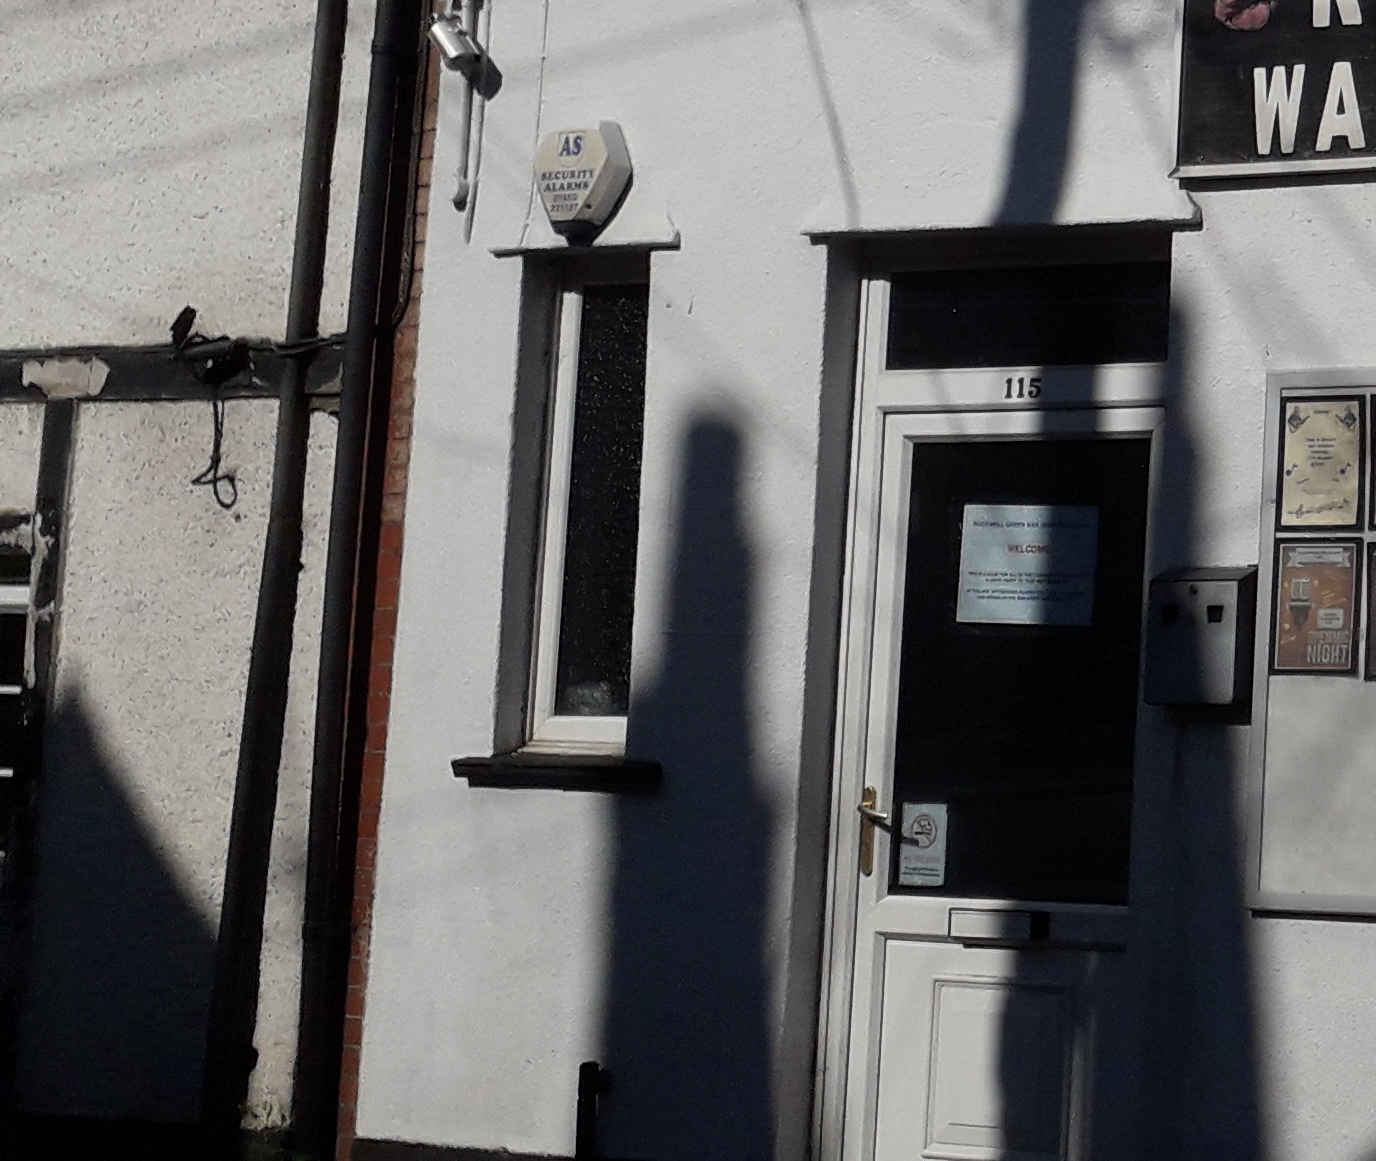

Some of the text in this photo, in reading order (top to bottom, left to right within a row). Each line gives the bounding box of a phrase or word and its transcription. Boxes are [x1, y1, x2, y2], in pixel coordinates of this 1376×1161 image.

[560, 135, 583, 157] AS
[541, 168, 595, 181] SECURITY
[544, 180, 590, 193] ALARMS
[1004, 377, 1042, 399] 115
[1306, 644, 1348, 664] NIGHT
